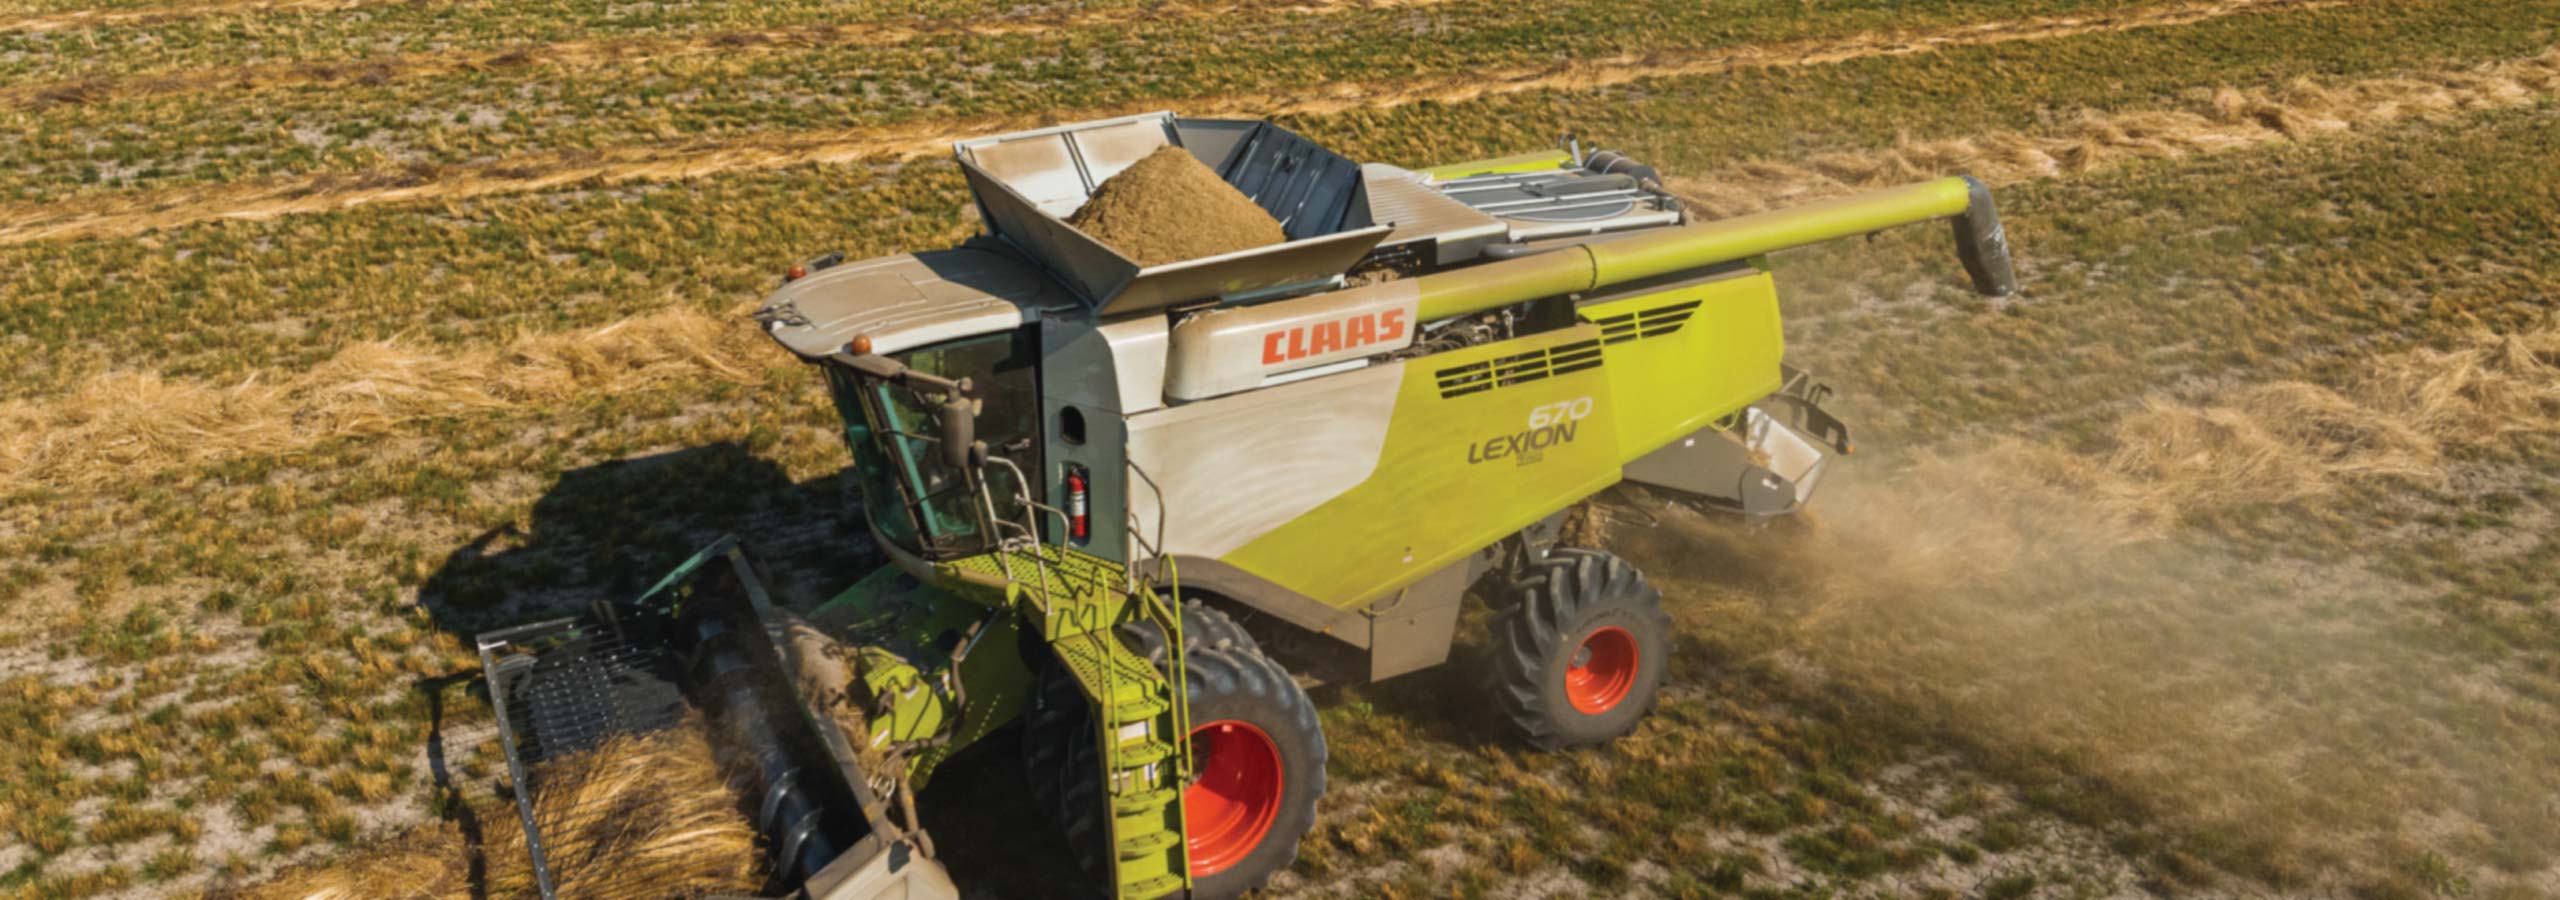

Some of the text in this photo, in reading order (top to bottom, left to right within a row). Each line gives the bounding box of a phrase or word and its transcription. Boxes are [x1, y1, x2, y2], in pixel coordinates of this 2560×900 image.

[1262, 308, 1405, 365] CLAAS
[1529, 396, 1593, 430] 670
[1468, 420, 1577, 464] LEXION
